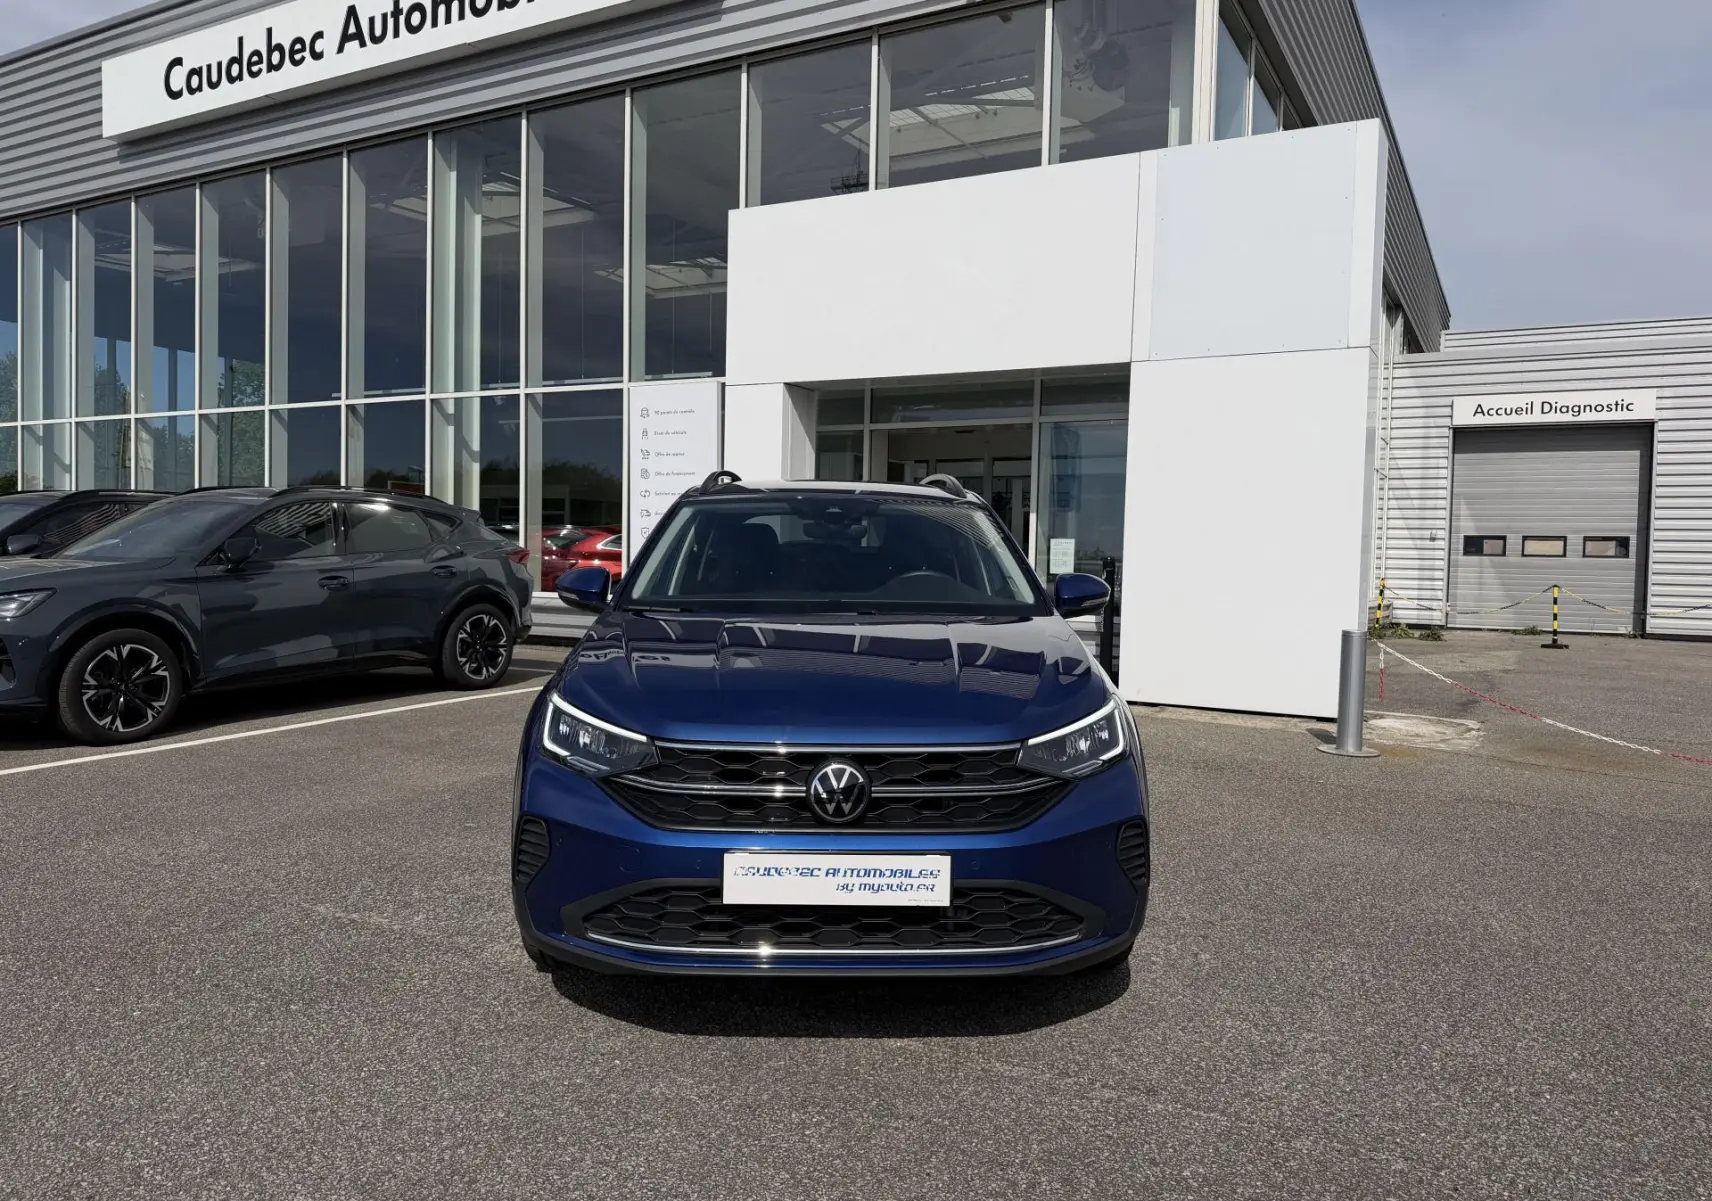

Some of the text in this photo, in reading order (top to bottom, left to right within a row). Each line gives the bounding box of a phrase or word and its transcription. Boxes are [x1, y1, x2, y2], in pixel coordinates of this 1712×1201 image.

[164, 0, 535, 101] Caudebec Automo
[1473, 399, 1634, 417] Accueil Diagnostic
[825, 867, 941, 879] AUTOMOBILES
